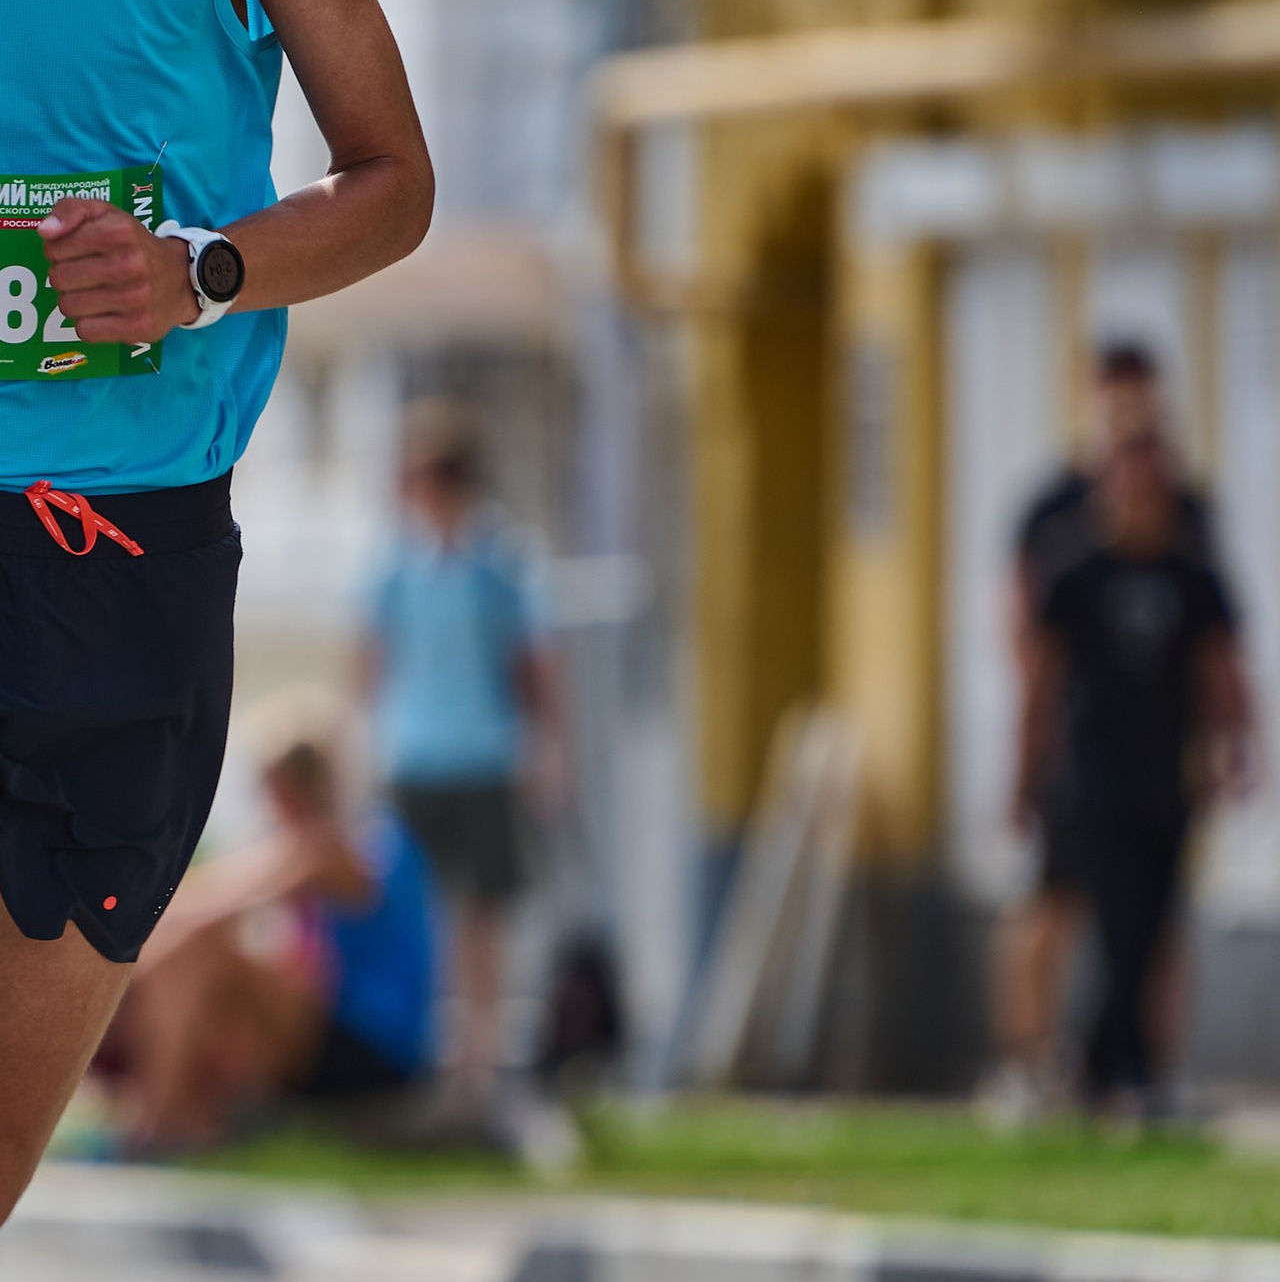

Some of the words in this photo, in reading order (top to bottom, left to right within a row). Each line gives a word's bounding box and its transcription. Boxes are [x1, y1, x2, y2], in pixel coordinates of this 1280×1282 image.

[30, 178, 110, 190] МЕЖДУНАРОДНЫЙ
[32, 207, 53, 215] ОКР
[3, 220, 41, 228] РОССИИ
